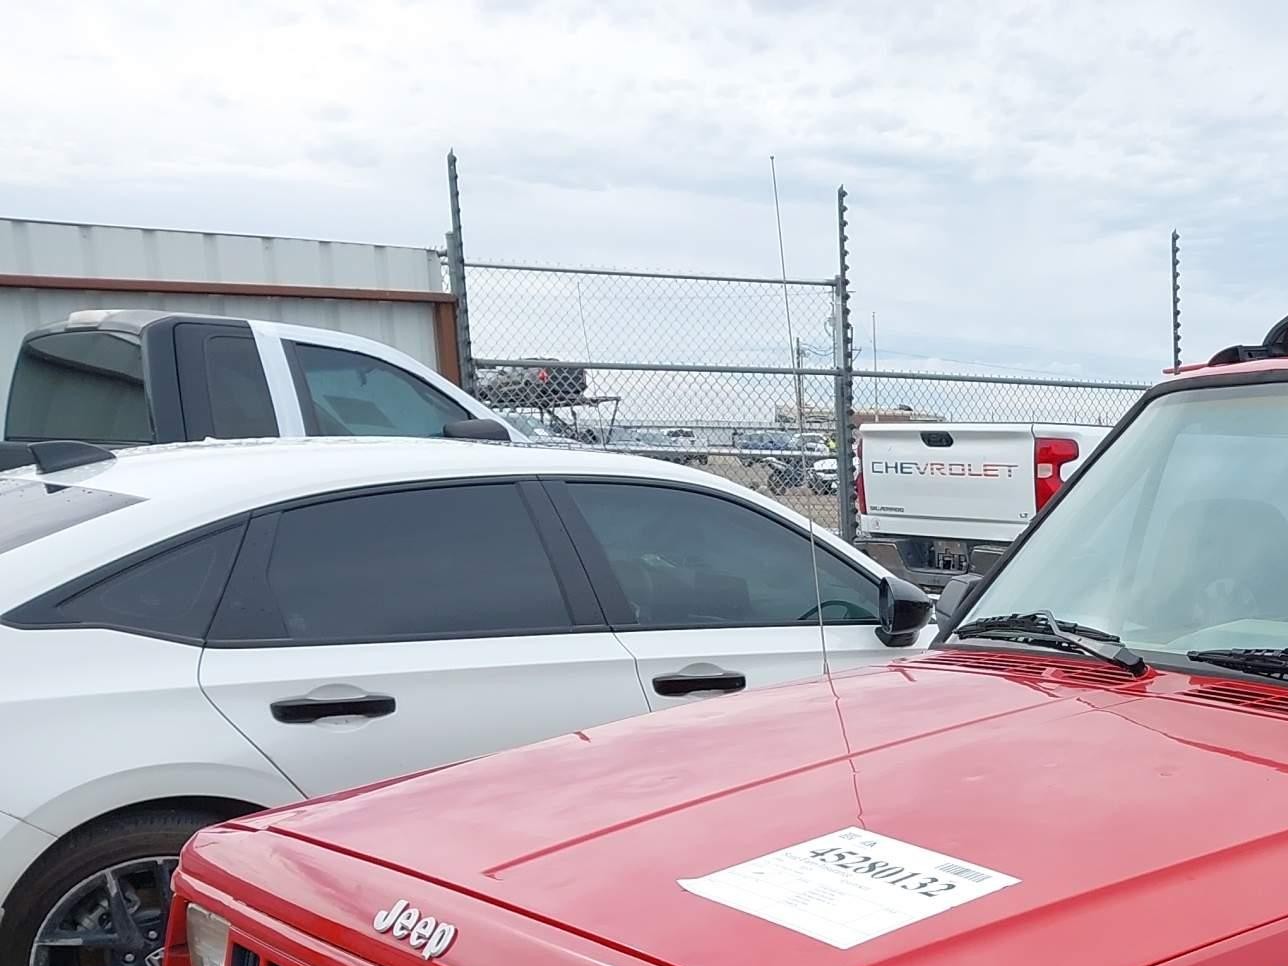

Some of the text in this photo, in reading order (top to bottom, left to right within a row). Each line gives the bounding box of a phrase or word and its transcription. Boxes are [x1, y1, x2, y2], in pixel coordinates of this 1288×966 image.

[871, 461, 1019, 478] CHEVROLET
[808, 847, 957, 898] 45280132
[373, 899, 457, 960] Jeep
